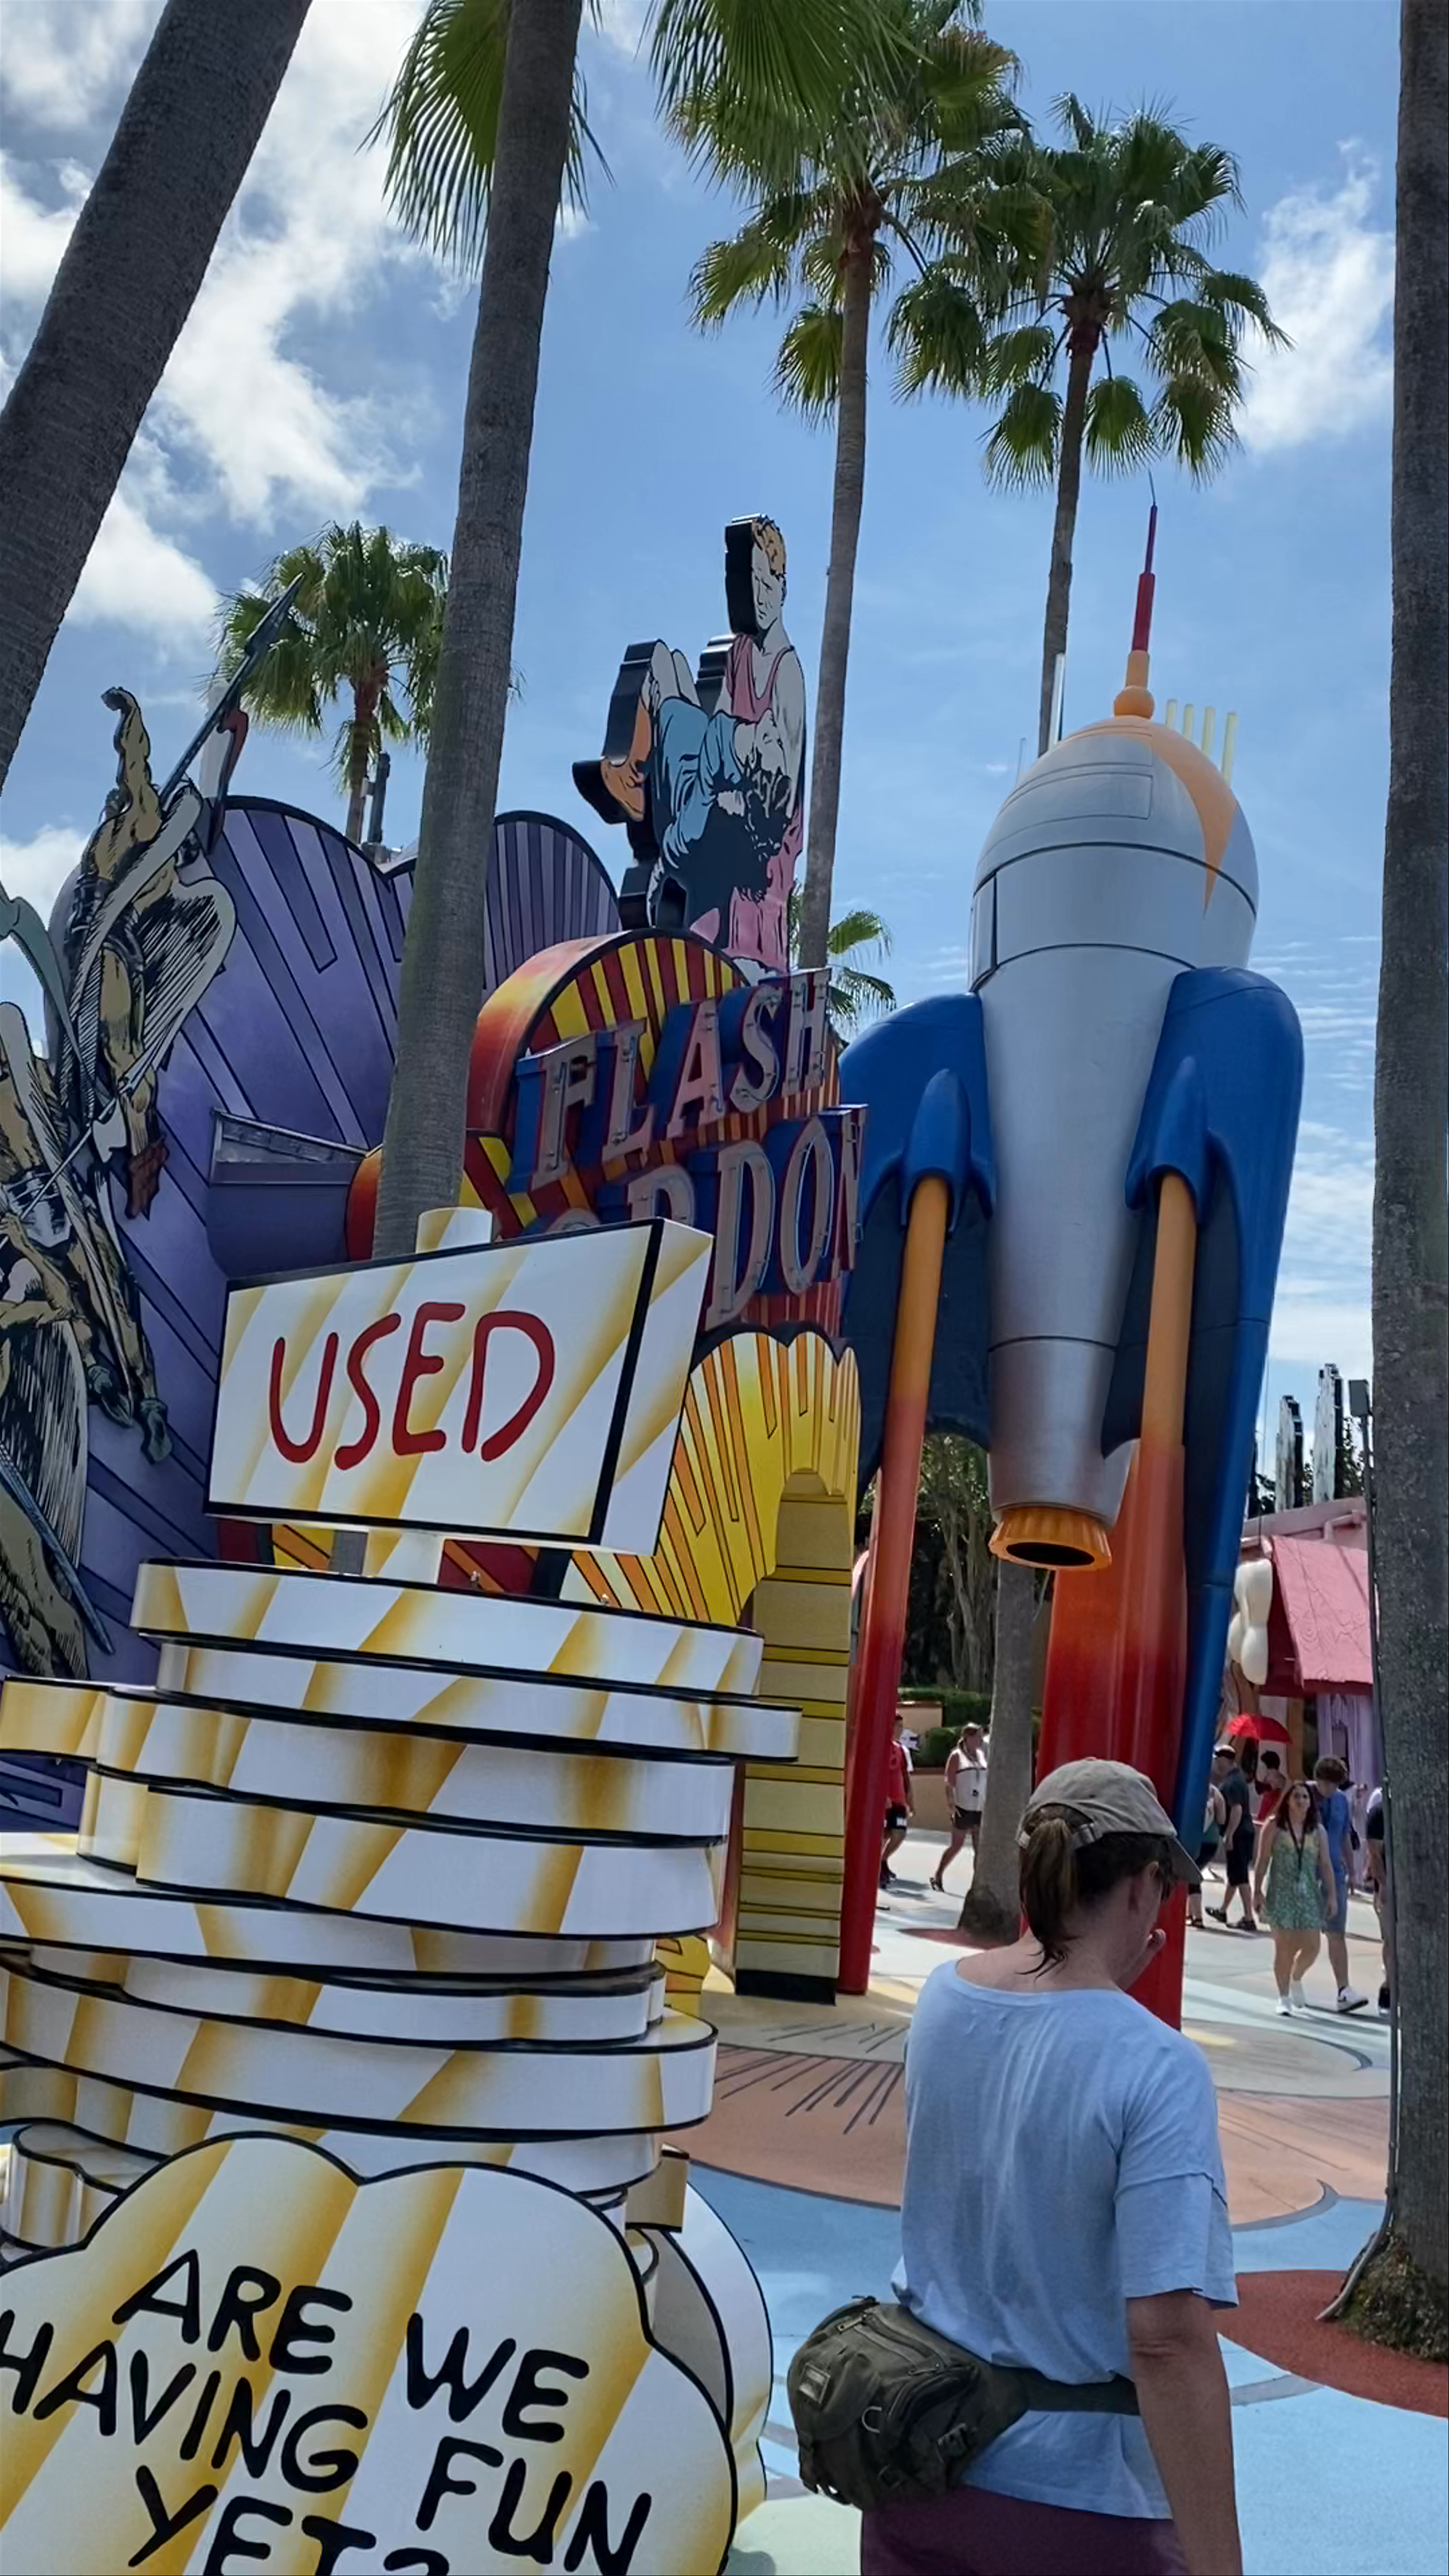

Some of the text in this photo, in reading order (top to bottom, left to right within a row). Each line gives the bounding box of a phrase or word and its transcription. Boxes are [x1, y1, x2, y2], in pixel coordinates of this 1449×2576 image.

[530, 970, 832, 1192] FLASH
[547, 1104, 869, 1332] DON
[270, 1303, 555, 1470] USED
[0, 2309, 652, 2576] HAVING FUN
[112, 2249, 589, 2443] ARE WE
